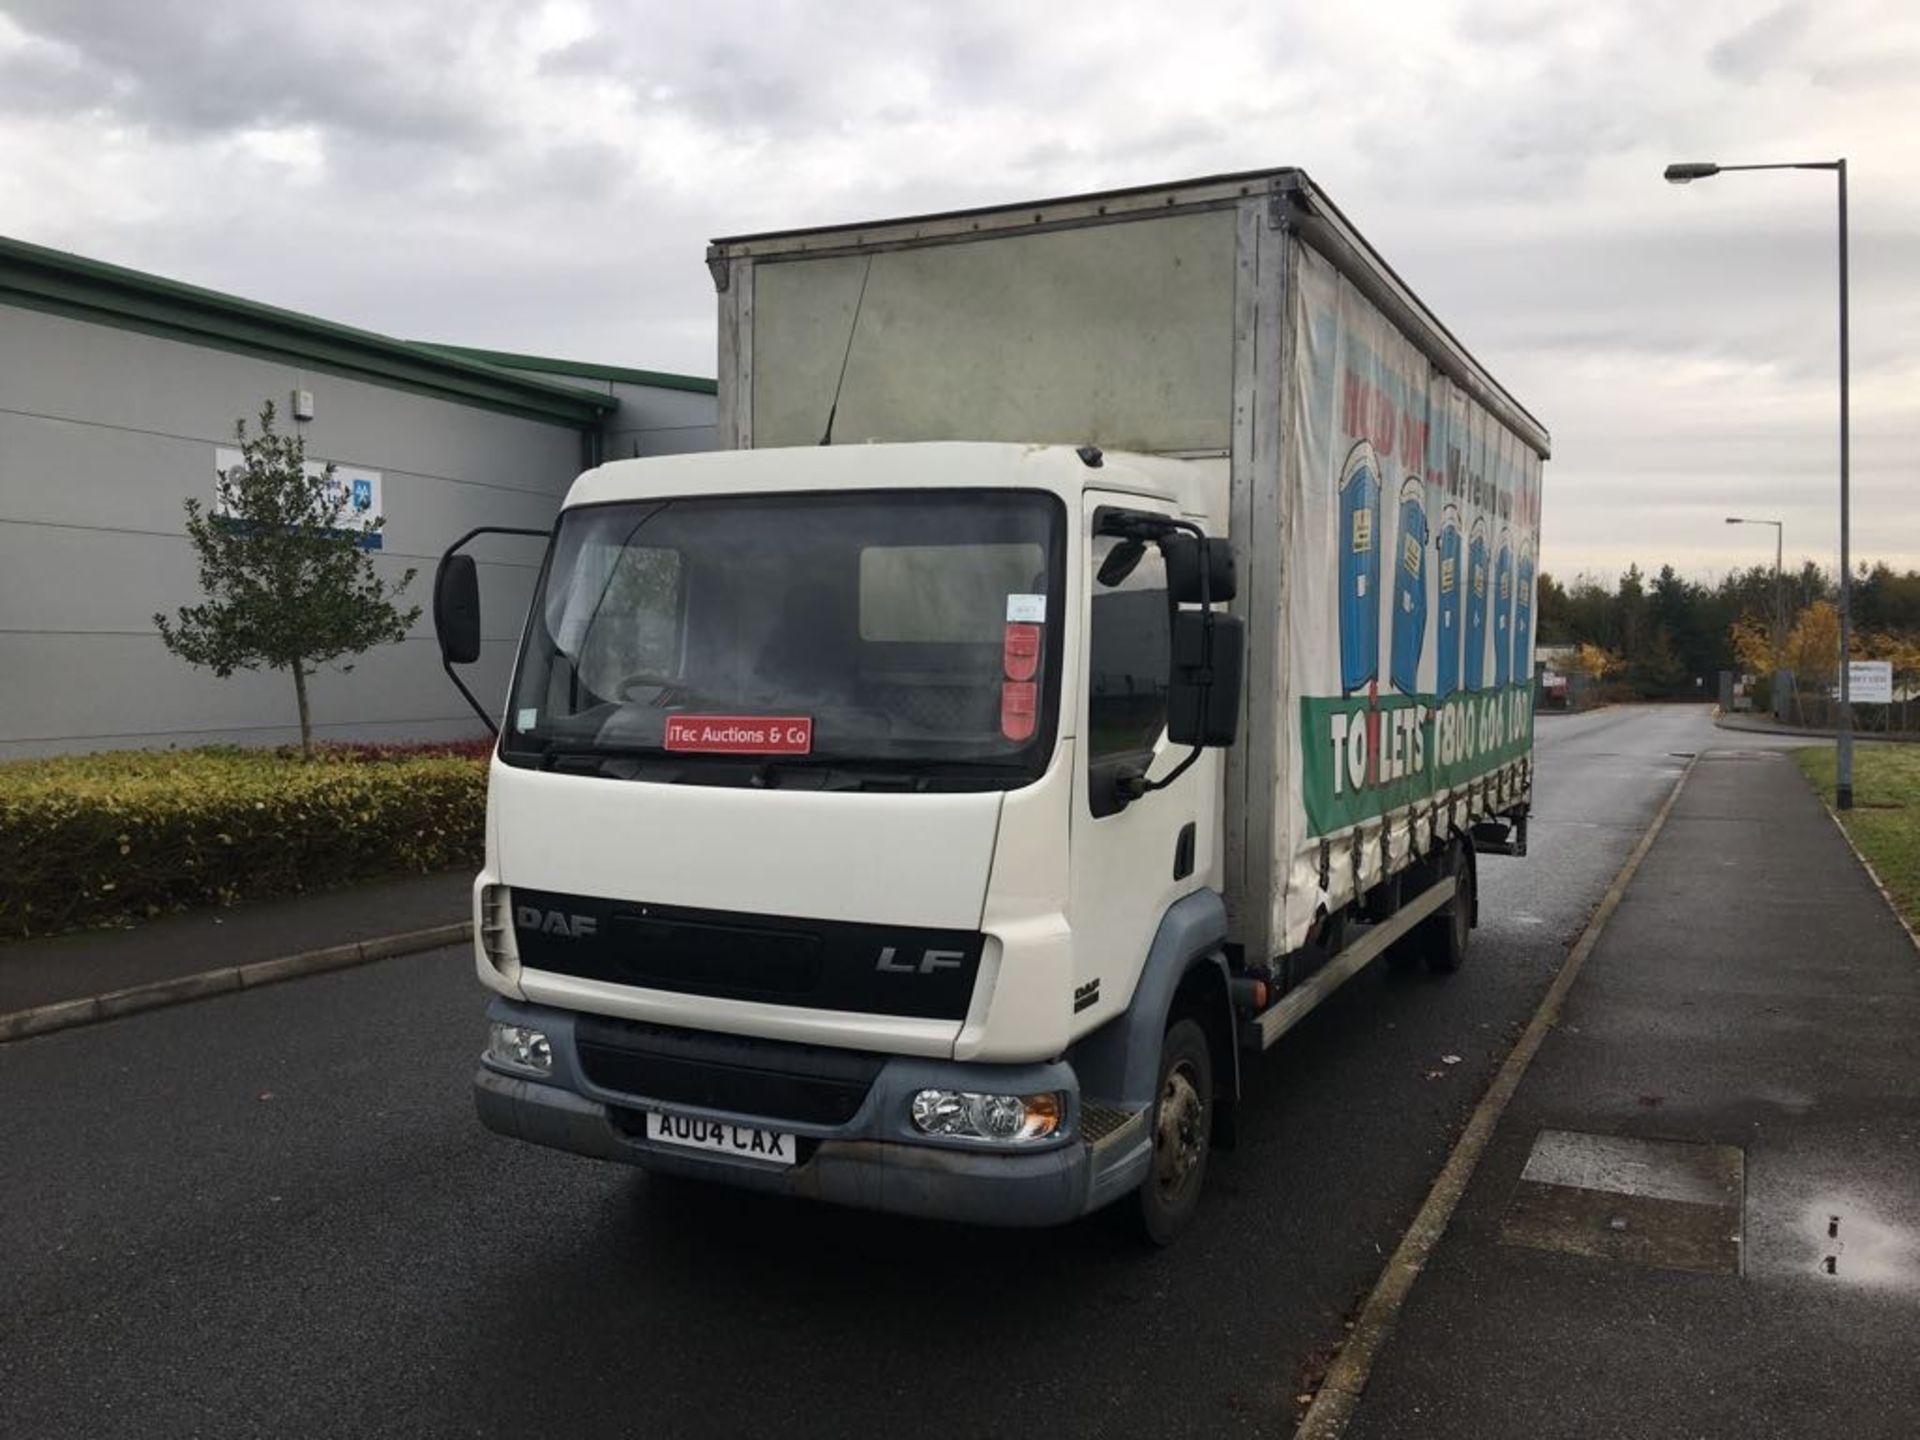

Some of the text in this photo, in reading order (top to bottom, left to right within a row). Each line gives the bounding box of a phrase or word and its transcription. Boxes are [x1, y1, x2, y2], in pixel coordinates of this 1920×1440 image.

[669, 726, 806, 743] iTec Auctions & Co
[1331, 684, 1427, 794] TOILETS
[1434, 701, 1475, 767] 1800
[1479, 694, 1504, 754] 606
[517, 906, 598, 938] DAF
[876, 946, 965, 974] LF
[732, 1126, 784, 1156] CAX
